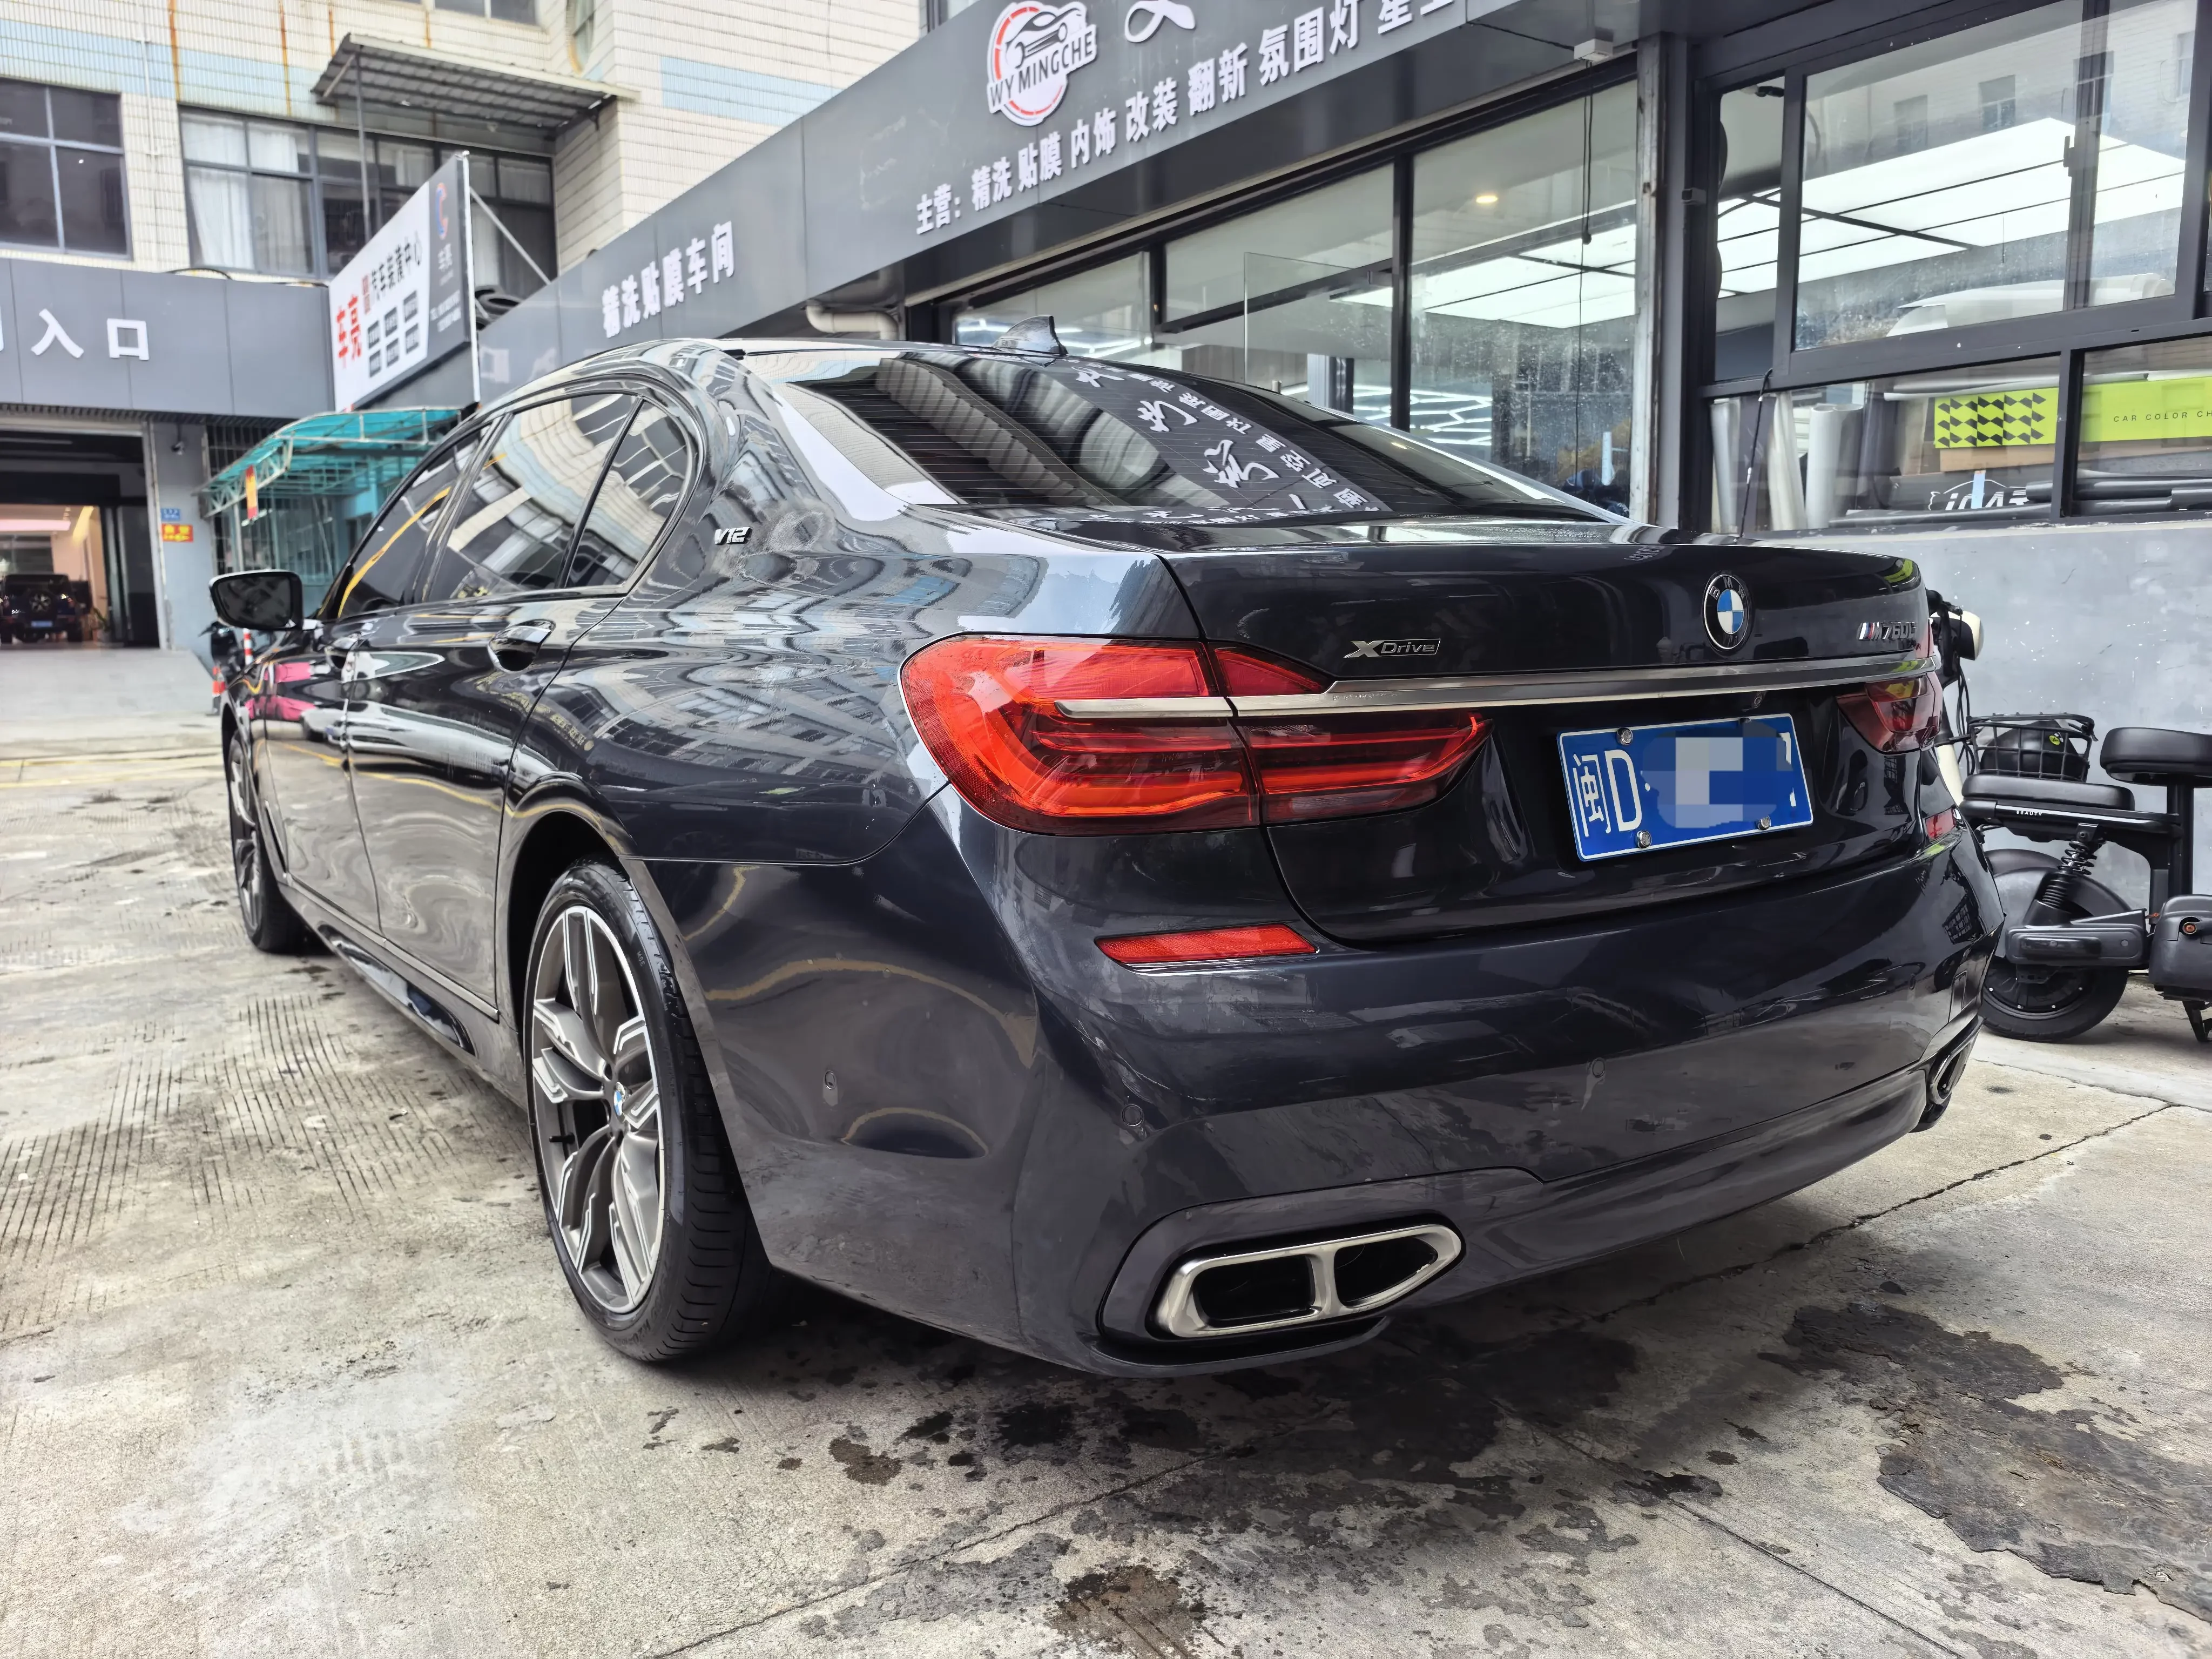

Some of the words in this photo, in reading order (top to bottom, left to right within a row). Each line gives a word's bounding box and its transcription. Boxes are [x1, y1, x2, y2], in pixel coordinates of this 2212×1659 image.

[990, 75, 1014, 107] WY
[1019, 31, 1093, 94] MINGCHE
[972, 157, 1013, 211] 精洗
[1018, 131, 1063, 192] 贴膜
[1070, 107, 1117, 168] 内饰
[1125, 77, 1179, 141] 改装
[1188, 43, 1248, 116] 翻新
[1259, 0, 1359, 86] 氛围灯
[1378, 0, 1454, 35] 星
[602, 220, 734, 339] 精洗贴膜车间
[0, 306, 150, 360] 入口
[2146, 412, 2188, 420] COLOR
[714, 527, 751, 544] V12
[1709, 577, 1745, 601] BMW
